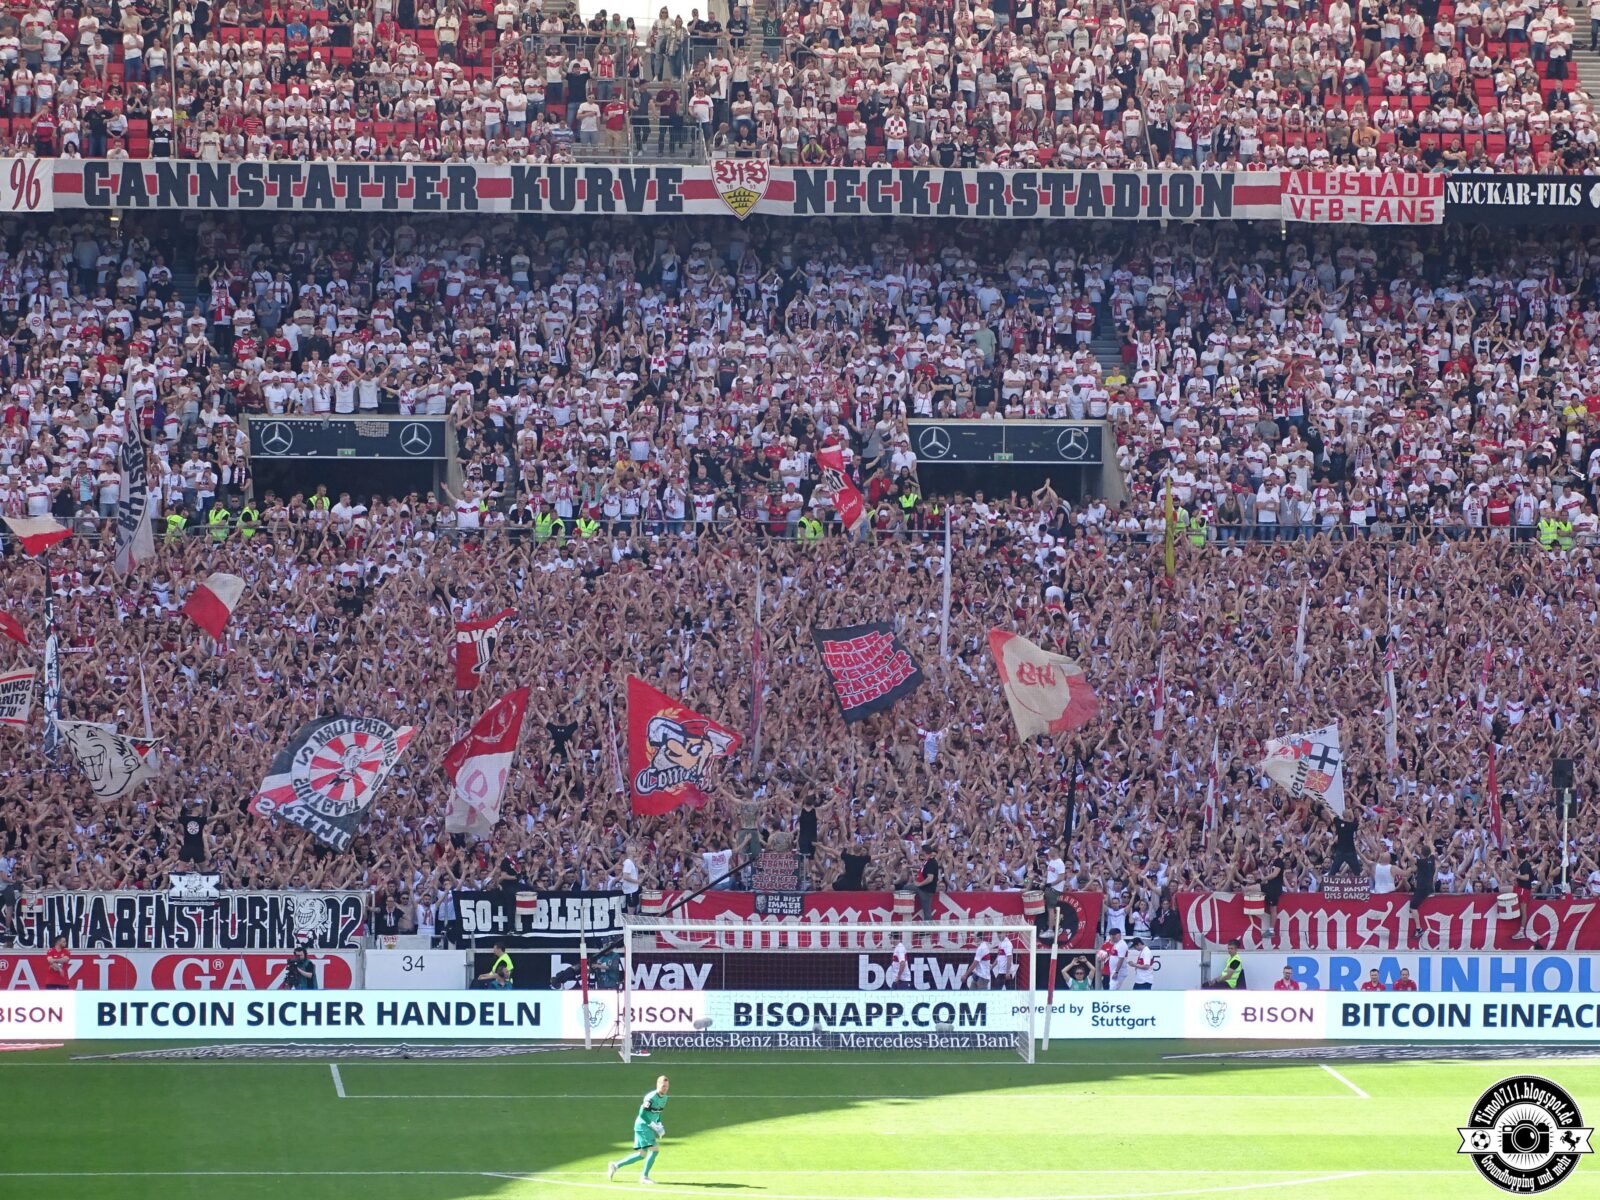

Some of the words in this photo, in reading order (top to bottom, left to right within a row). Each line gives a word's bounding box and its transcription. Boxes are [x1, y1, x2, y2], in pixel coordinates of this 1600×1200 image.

[84, 161, 478, 211] CANNSTATTER
[511, 165, 683, 212] KURVE
[793, 168, 1235, 219] NECKARSTADION
[1286, 171, 1442, 196] ALBSTADT
[1446, 182, 1582, 207] NECKAR-FILS
[1290, 196, 1435, 223] VFB-FANS
[1323, 876, 1352, 885] ULTRA
[531, 896, 627, 931] BLEIBT
[1525, 903, 1596, 950] 97
[402, 955, 426, 972] 34
[100, 1001, 233, 1026] BITCOIN
[246, 1001, 366, 1026] SICHER
[377, 1001, 541, 1026] HANDELN
[733, 1001, 987, 1027] BISONAPP.COM
[1070, 1003, 1084, 1016] by
[1092, 1001, 1131, 1014] Börse
[1241, 1006, 1314, 1023] BISON
[1342, 1002, 1471, 1028] BITCOIN
[1483, 1002, 1600, 1028] EINFAC
[1091, 1015, 1157, 1030] Stuttgart
[640, 1032, 772, 1049] Mercedes-Benz
[779, 1032, 822, 1049] Bank
[839, 1032, 977, 1049] Mercedes-Benz
[980, 1032, 1020, 1049] Bank
